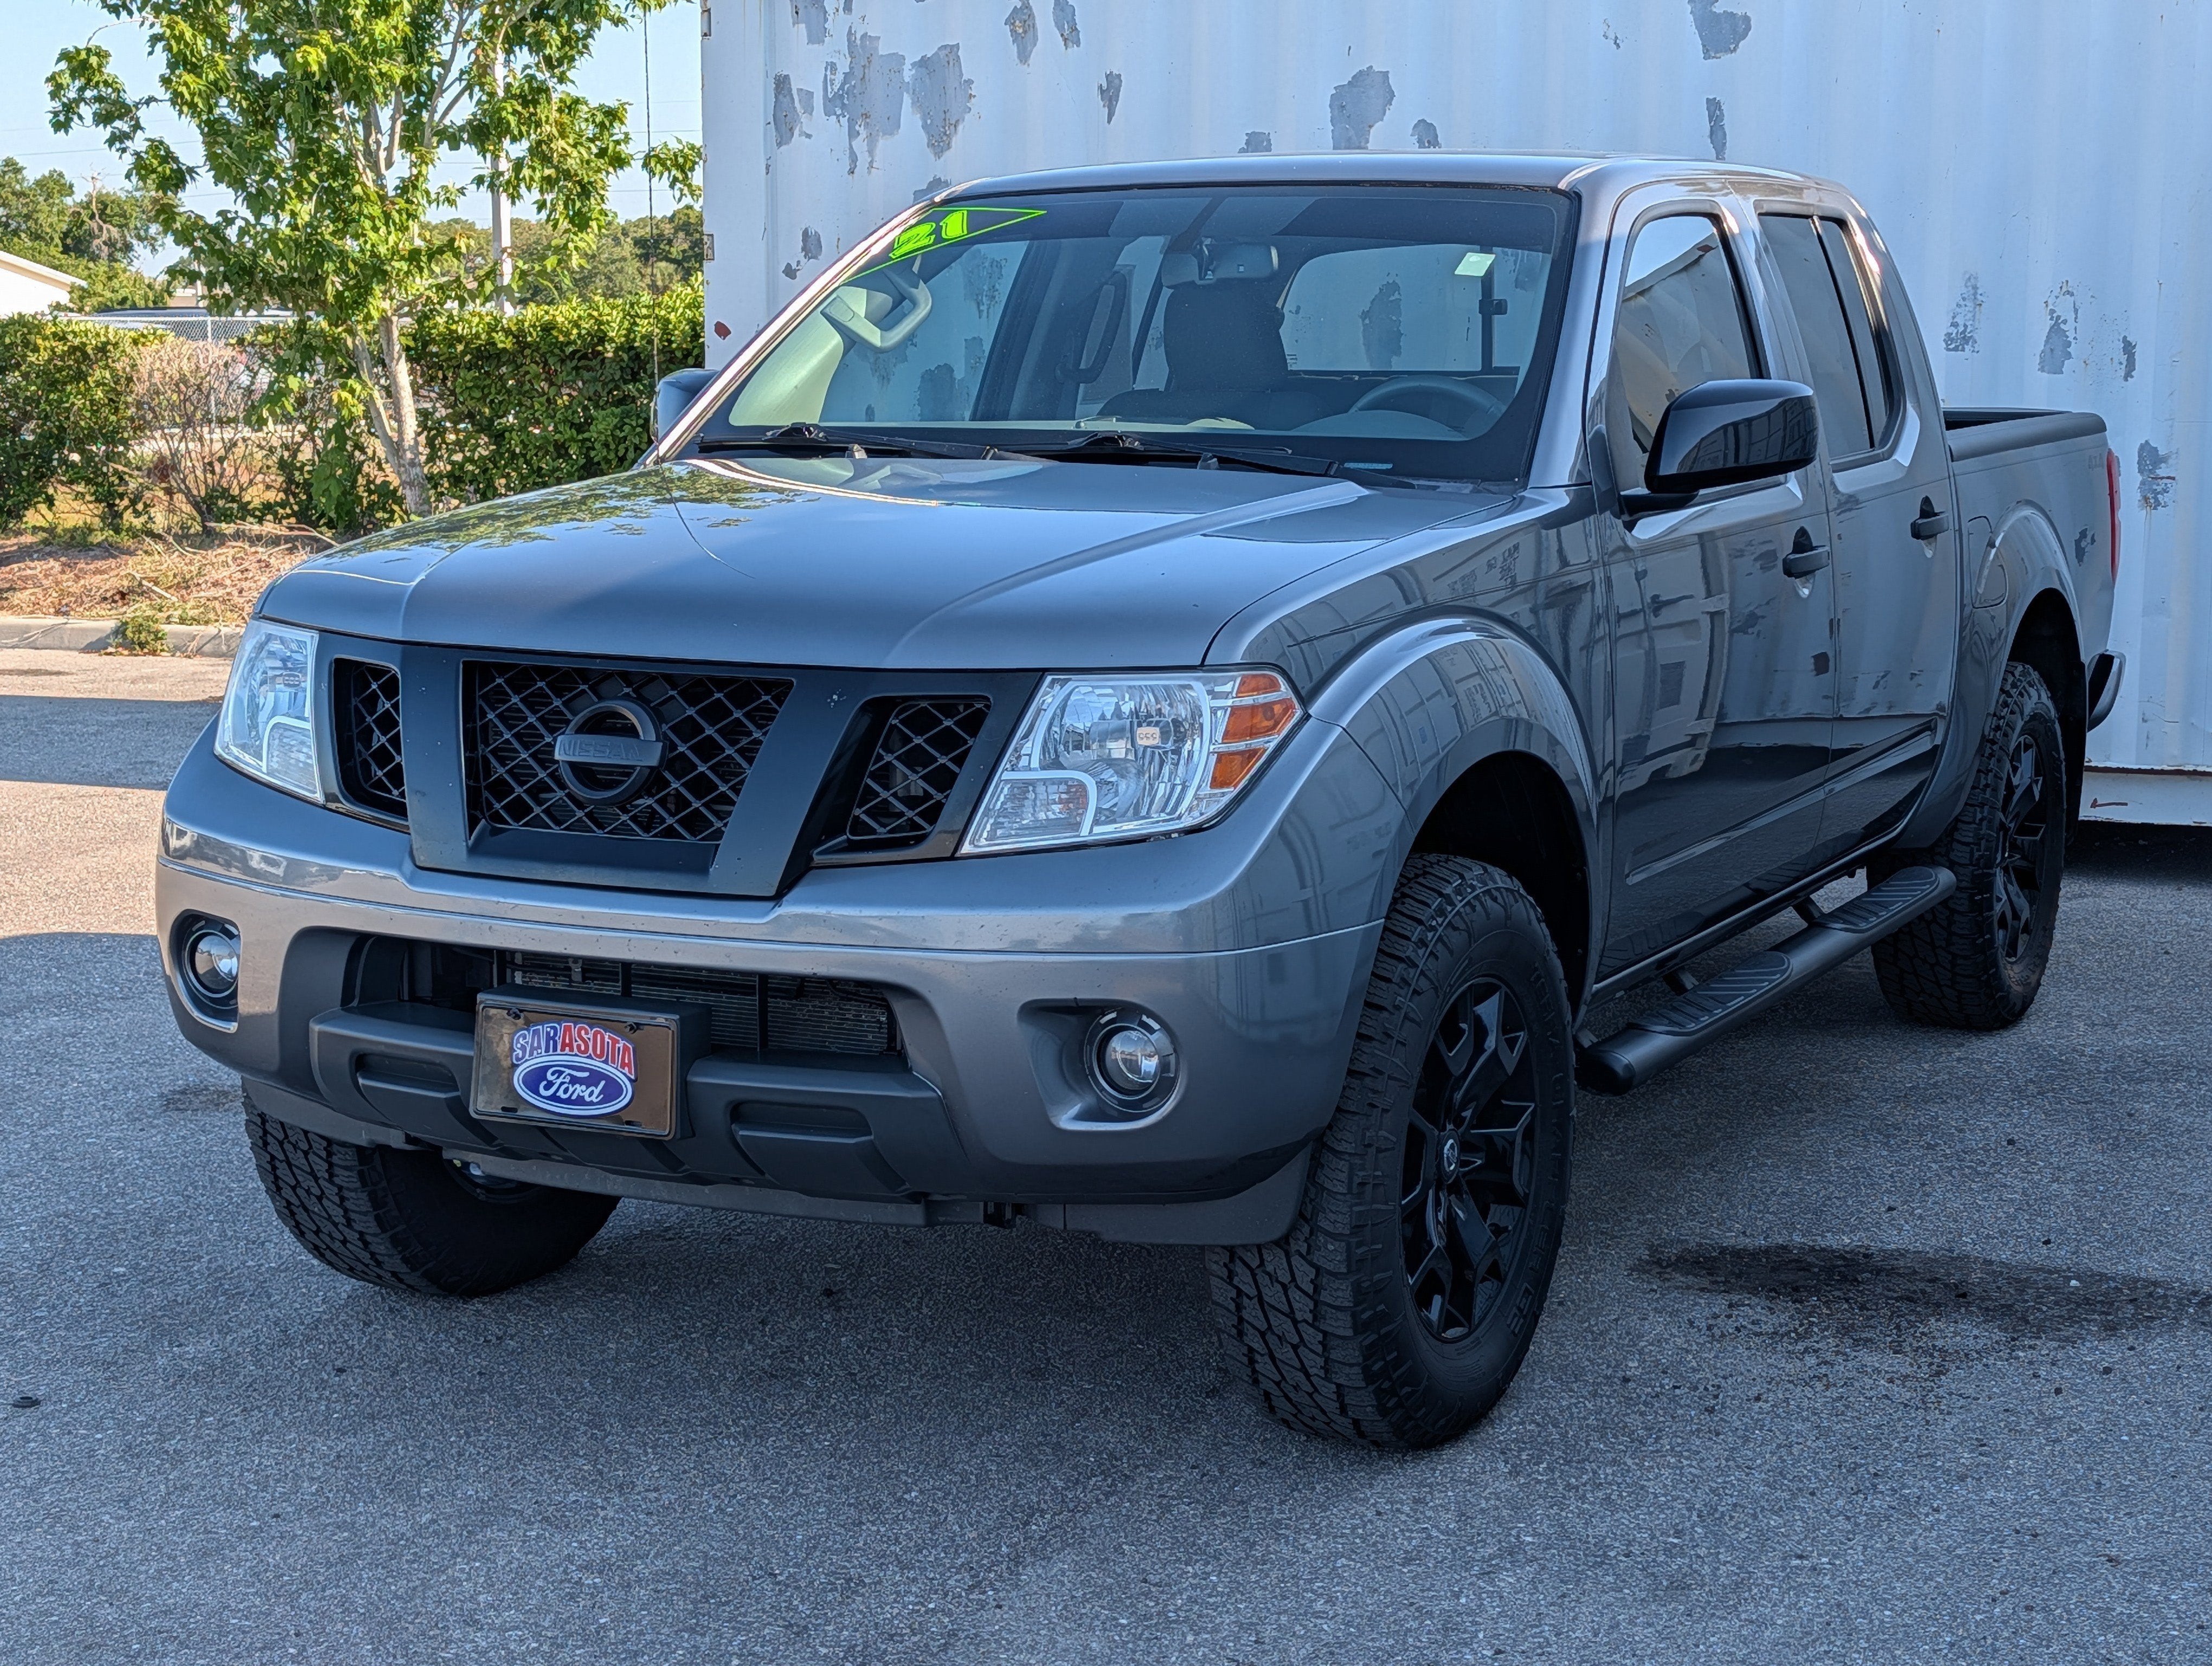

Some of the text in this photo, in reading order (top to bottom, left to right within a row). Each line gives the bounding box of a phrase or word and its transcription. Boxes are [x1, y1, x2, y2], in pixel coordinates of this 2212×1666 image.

[888, 209, 968, 259] 21
[513, 1022, 636, 1080] SARASOTA
[539, 1066, 606, 1103] Ford
